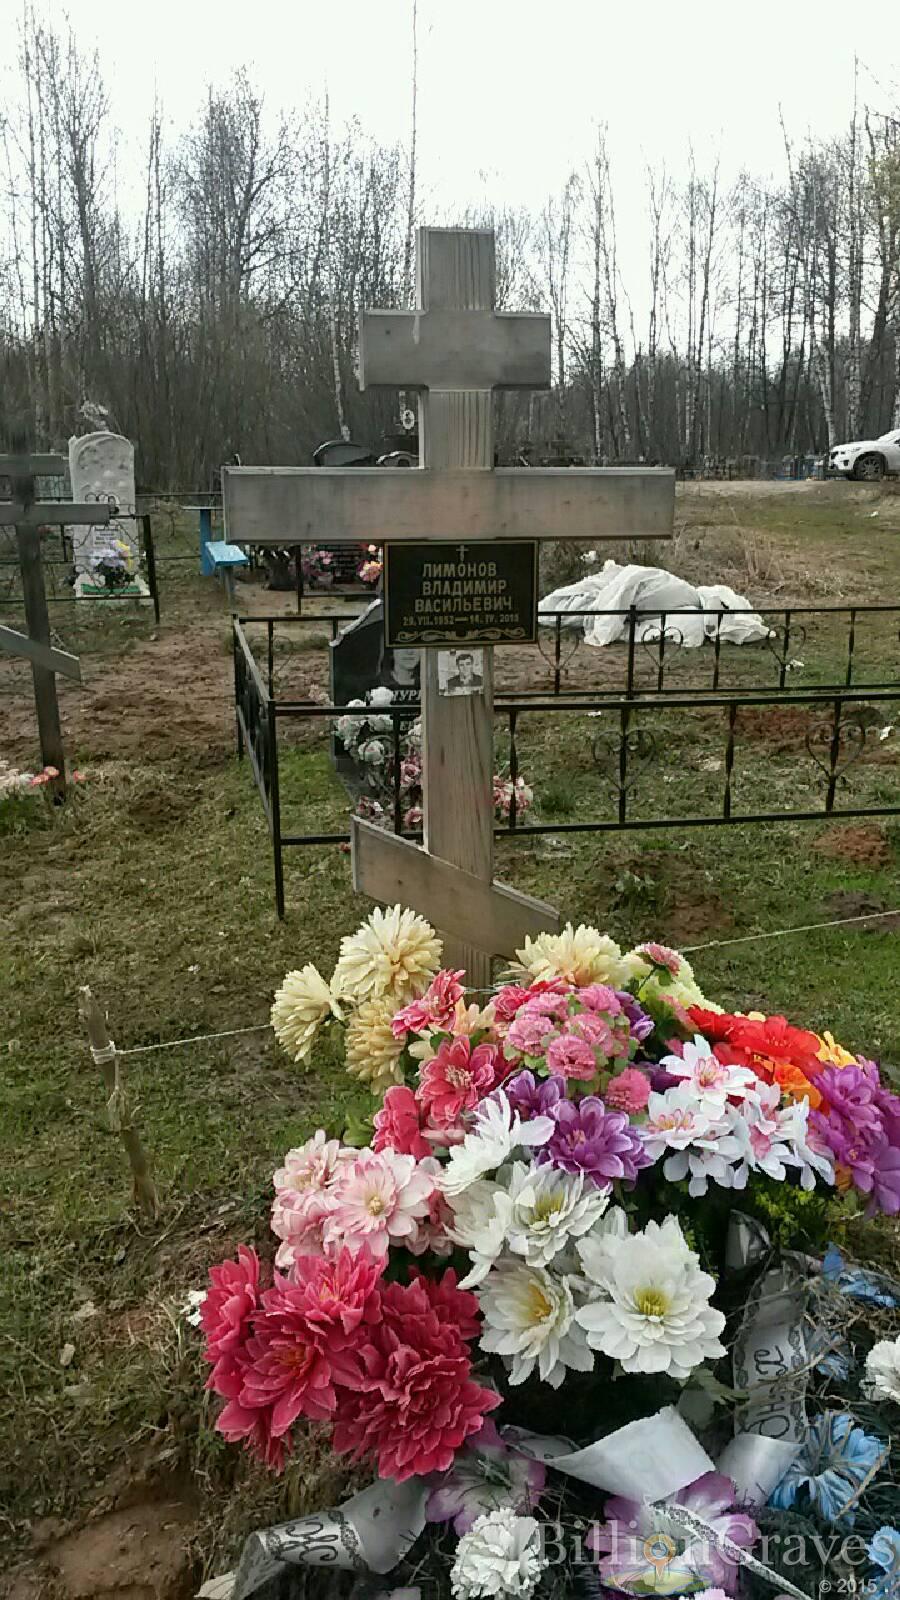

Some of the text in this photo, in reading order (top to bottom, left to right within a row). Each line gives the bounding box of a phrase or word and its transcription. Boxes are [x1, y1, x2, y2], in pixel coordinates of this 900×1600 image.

[422, 562, 497, 577] ЛИМОНОВ
[422, 579, 507, 597] ВЛАДИМИР
[414, 596, 513, 613] ВАСИЛЬЕВИЧ
